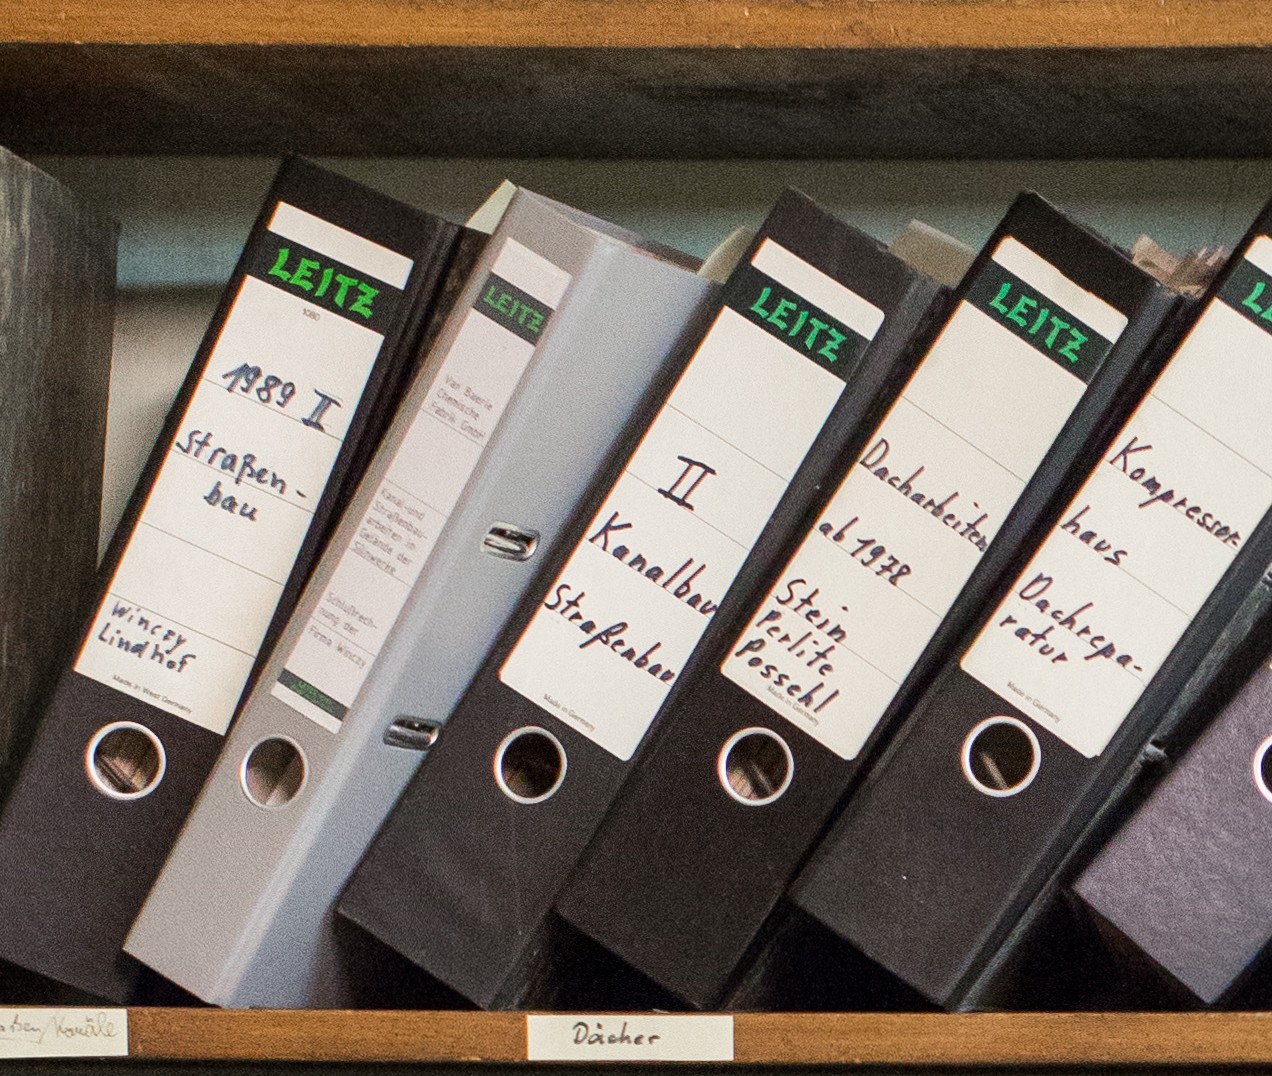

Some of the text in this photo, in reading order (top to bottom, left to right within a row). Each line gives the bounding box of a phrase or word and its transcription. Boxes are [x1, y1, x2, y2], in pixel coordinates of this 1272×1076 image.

[268, 248, 379, 317] LEITZ
[482, 285, 545, 334] LEITZ
[750, 287, 847, 364] LEITZ
[988, 283, 1088, 363] LEITZ
[222, 362, 296, 409] 1989
[204, 482, 257, 522] bau
[658, 455, 717, 511] II
[860, 438, 987, 552] Dacharbeiten
[590, 511, 718, 619] Kanalbau
[818, 515, 913, 586] ab 1978
[1059, 506, 1128, 567] haus
[543, 584, 676, 684] Straßenbau
[776, 579, 850, 643] Stein
[999, 615, 1067, 664] ratur
[1019, 572, 1143, 675] Dachrepa-
[98, 624, 195, 674] Lindhof
[573, 1021, 660, 1045] Dächer
